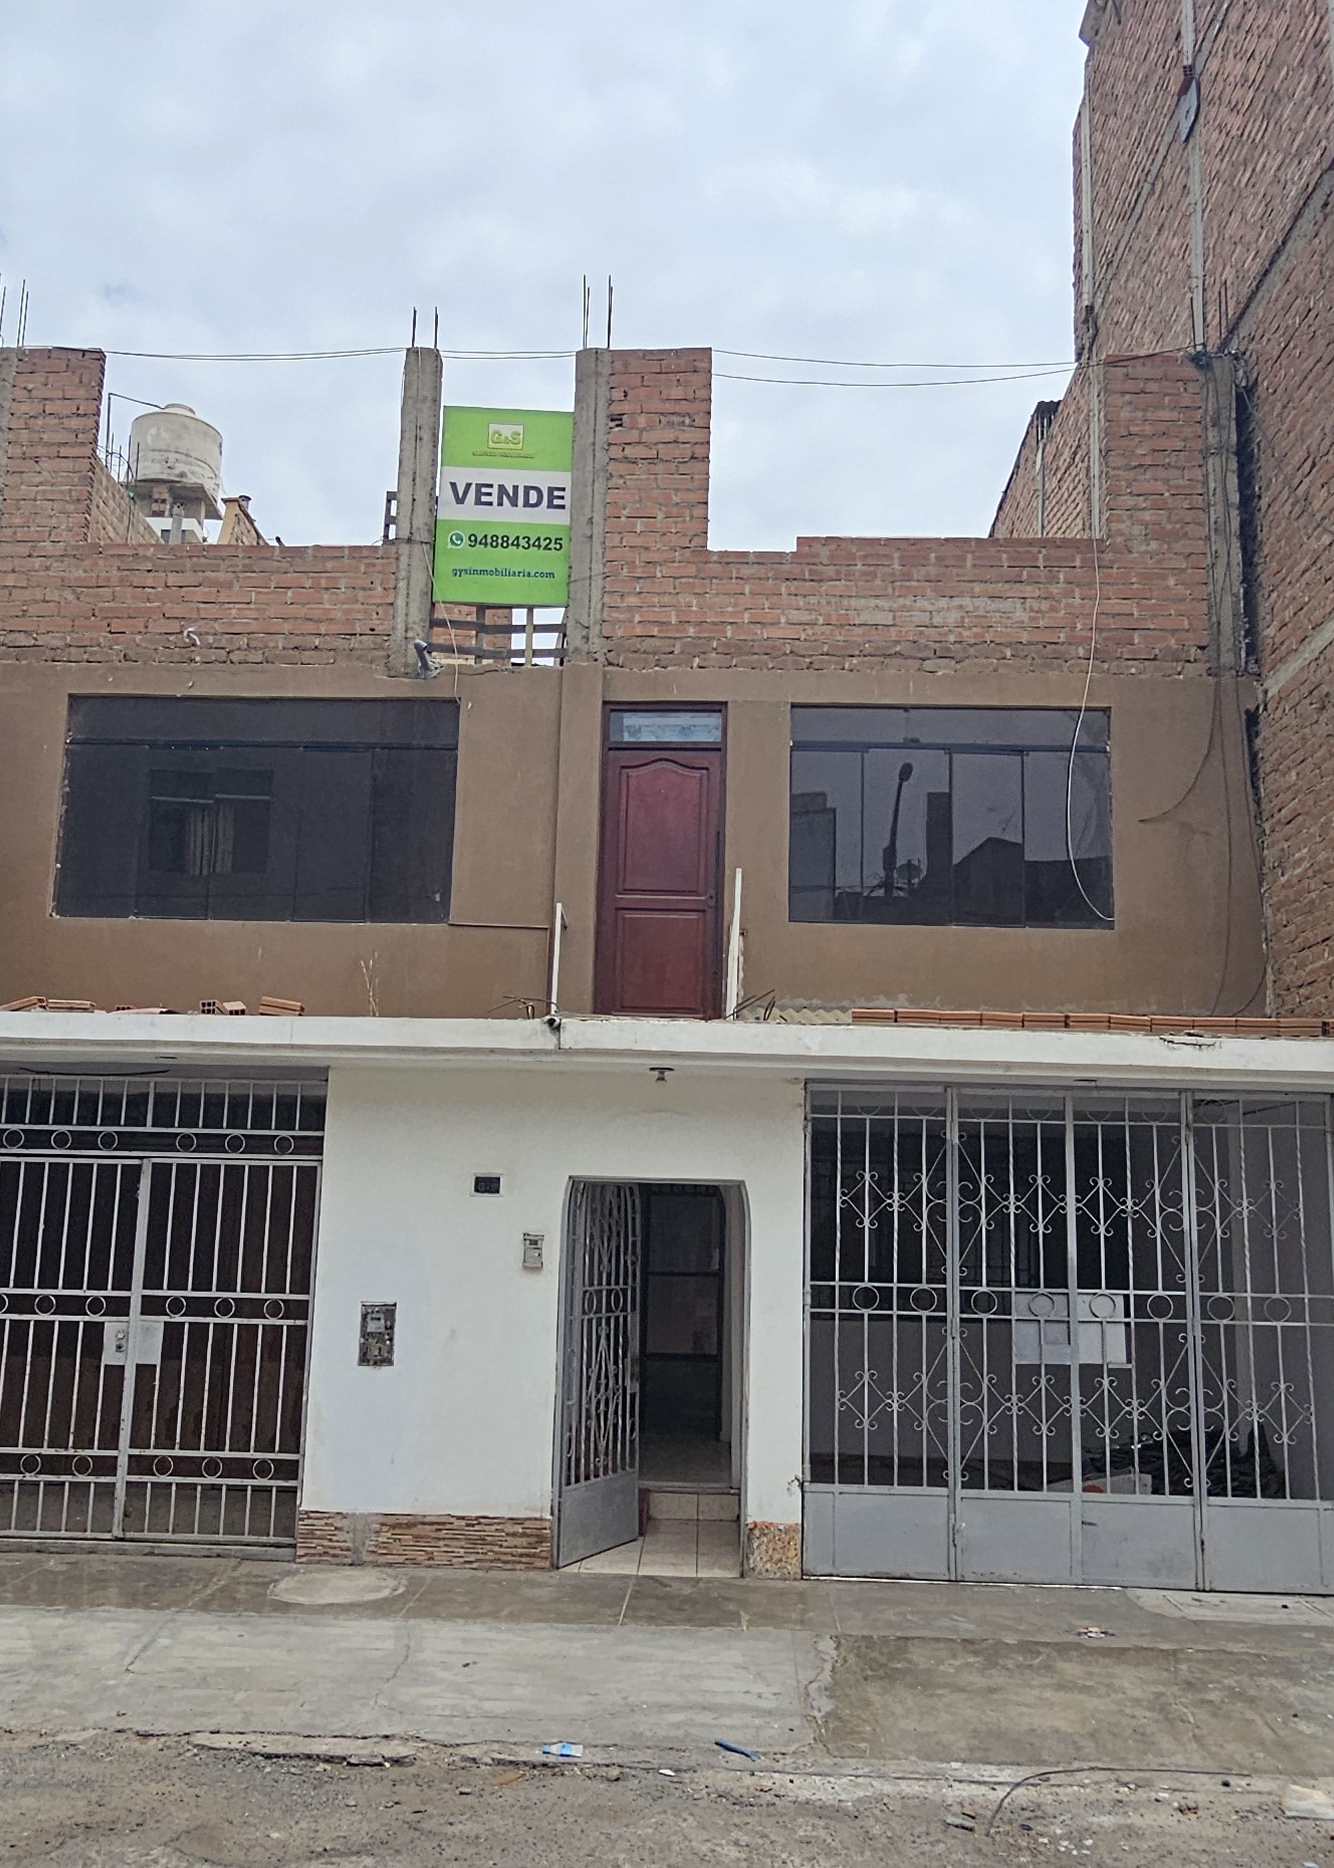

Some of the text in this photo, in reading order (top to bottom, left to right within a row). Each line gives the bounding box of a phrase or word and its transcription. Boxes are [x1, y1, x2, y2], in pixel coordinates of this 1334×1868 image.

[449, 481, 566, 510] VENDE
[468, 533, 563, 551] 948843425
[452, 566, 556, 579] gysinmobiliaria.com
